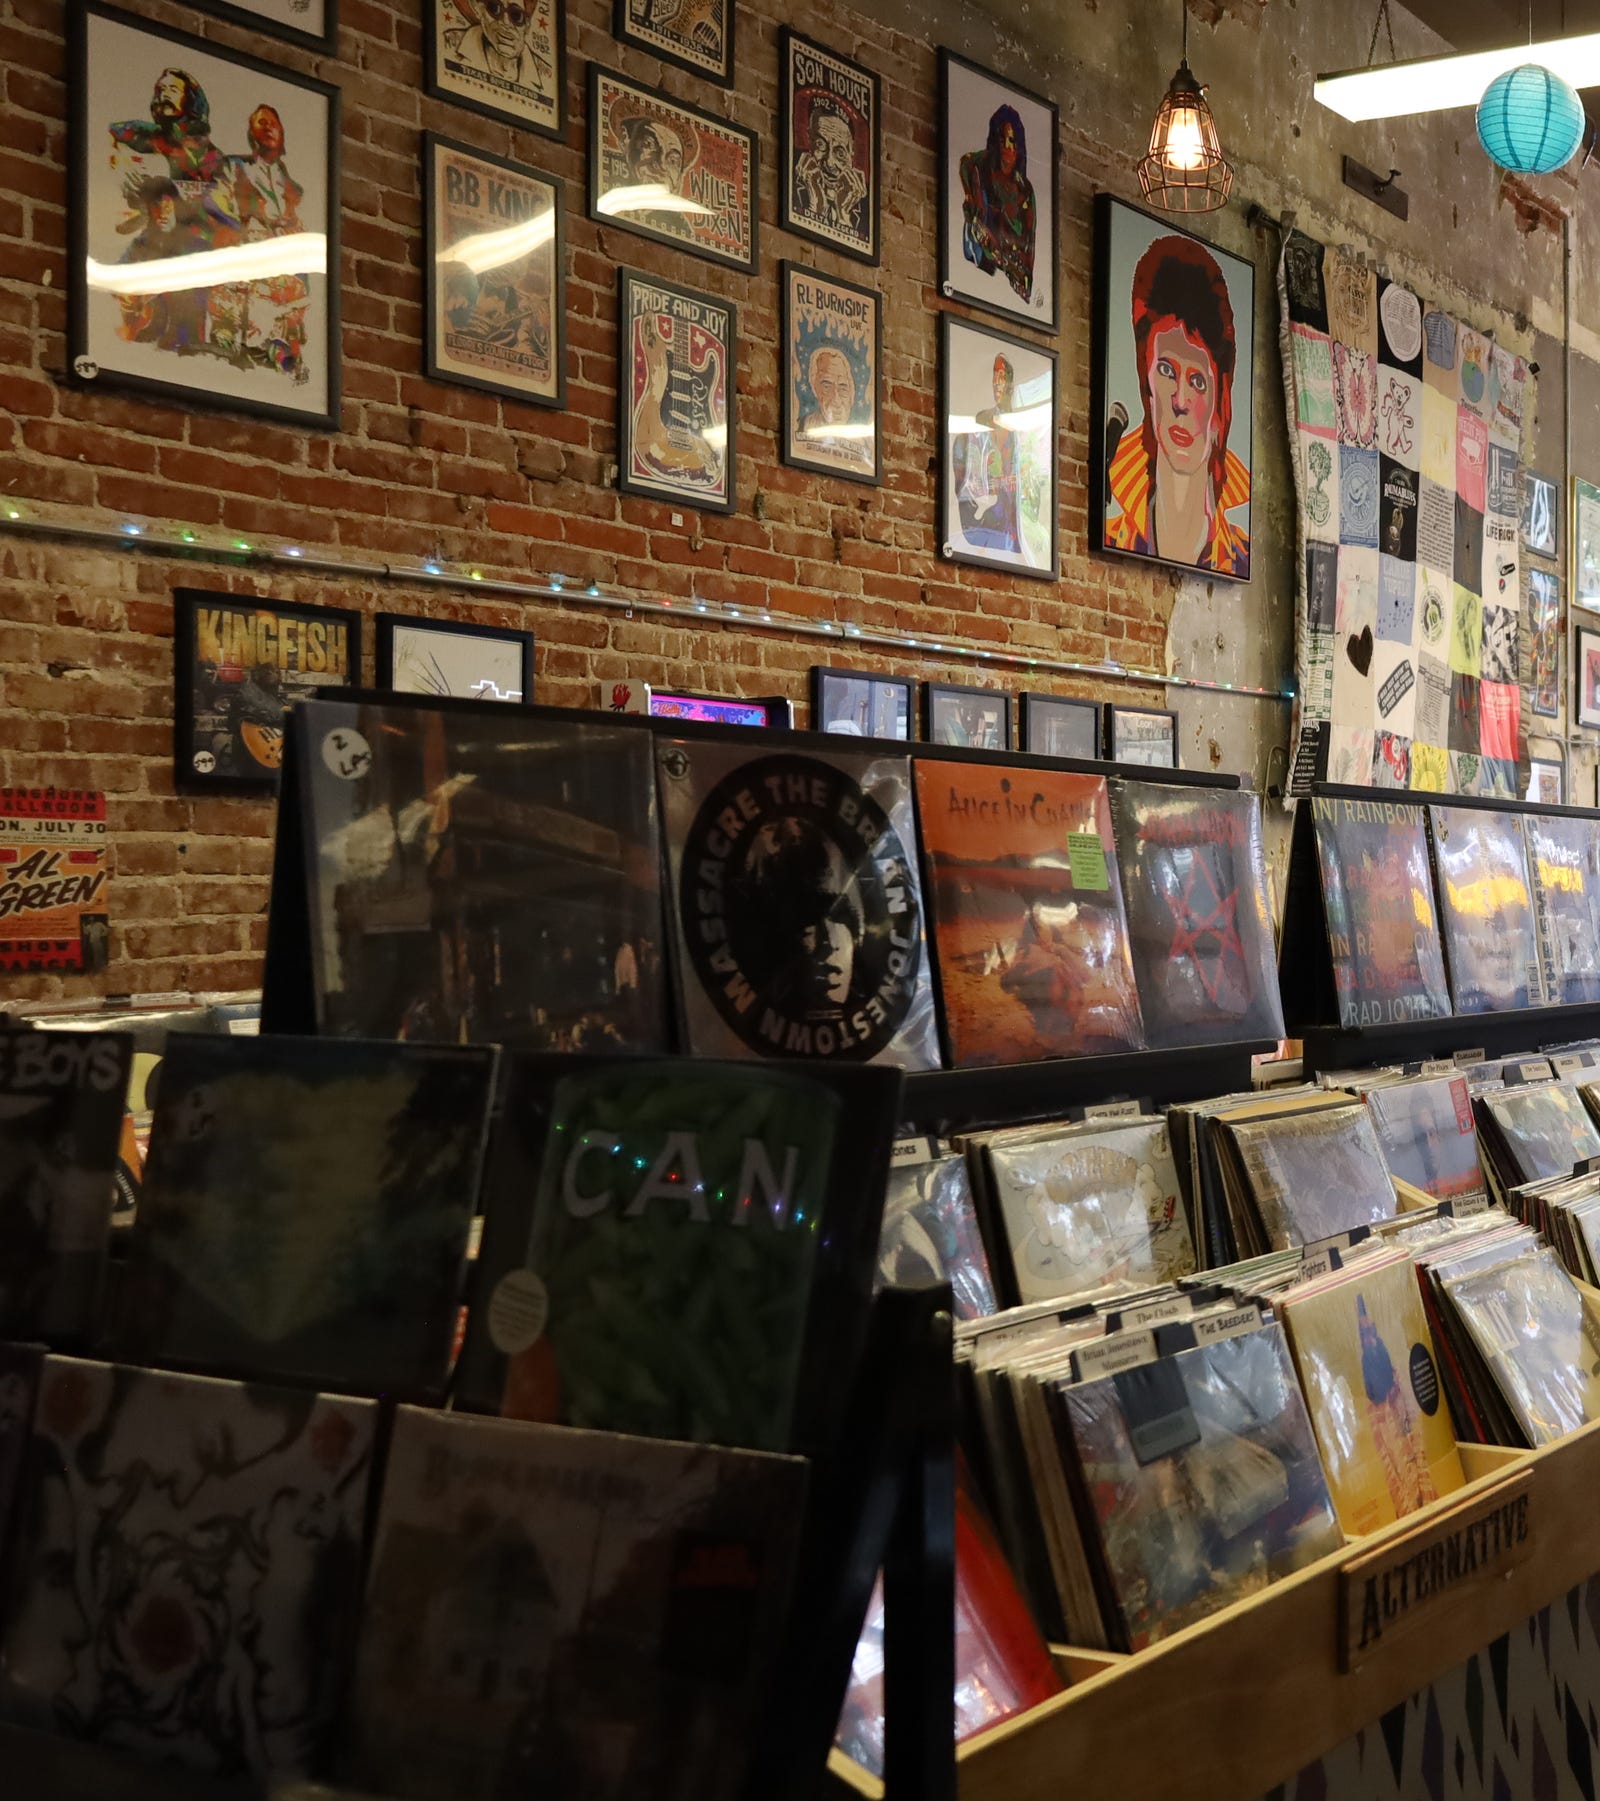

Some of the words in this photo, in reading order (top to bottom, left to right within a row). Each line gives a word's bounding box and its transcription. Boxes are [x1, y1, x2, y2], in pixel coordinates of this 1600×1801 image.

[795, 52, 823, 88] SON
[829, 72, 869, 120] HOUSE
[446, 164, 480, 208] BB
[632, 285, 670, 315] PRIDE
[672, 299, 700, 322] AND
[703, 308, 726, 341] JOY
[816, 285, 869, 324] BURNSIDE
[197, 607, 349, 676] KINGFISH
[0, 801, 97, 814] ALLROOM
[764, 774, 831, 808] THE
[34, 821, 76, 833] JULY
[84, 823, 106, 833] 30
[6, 849, 63, 881] AL
[0, 869, 106, 918] GREEN
[696, 787, 763, 1015] MASSACRE
[14, 1033, 122, 1092] BOYS
[562, 1129, 800, 1233] CAN
[1301, 1260, 1327, 1280] Fighters
[1199, 1323, 1216, 1335] THE
[1216, 1311, 1256, 1330] BREEDERS
[1358, 1493, 1529, 1650] ALTERNATIVE
